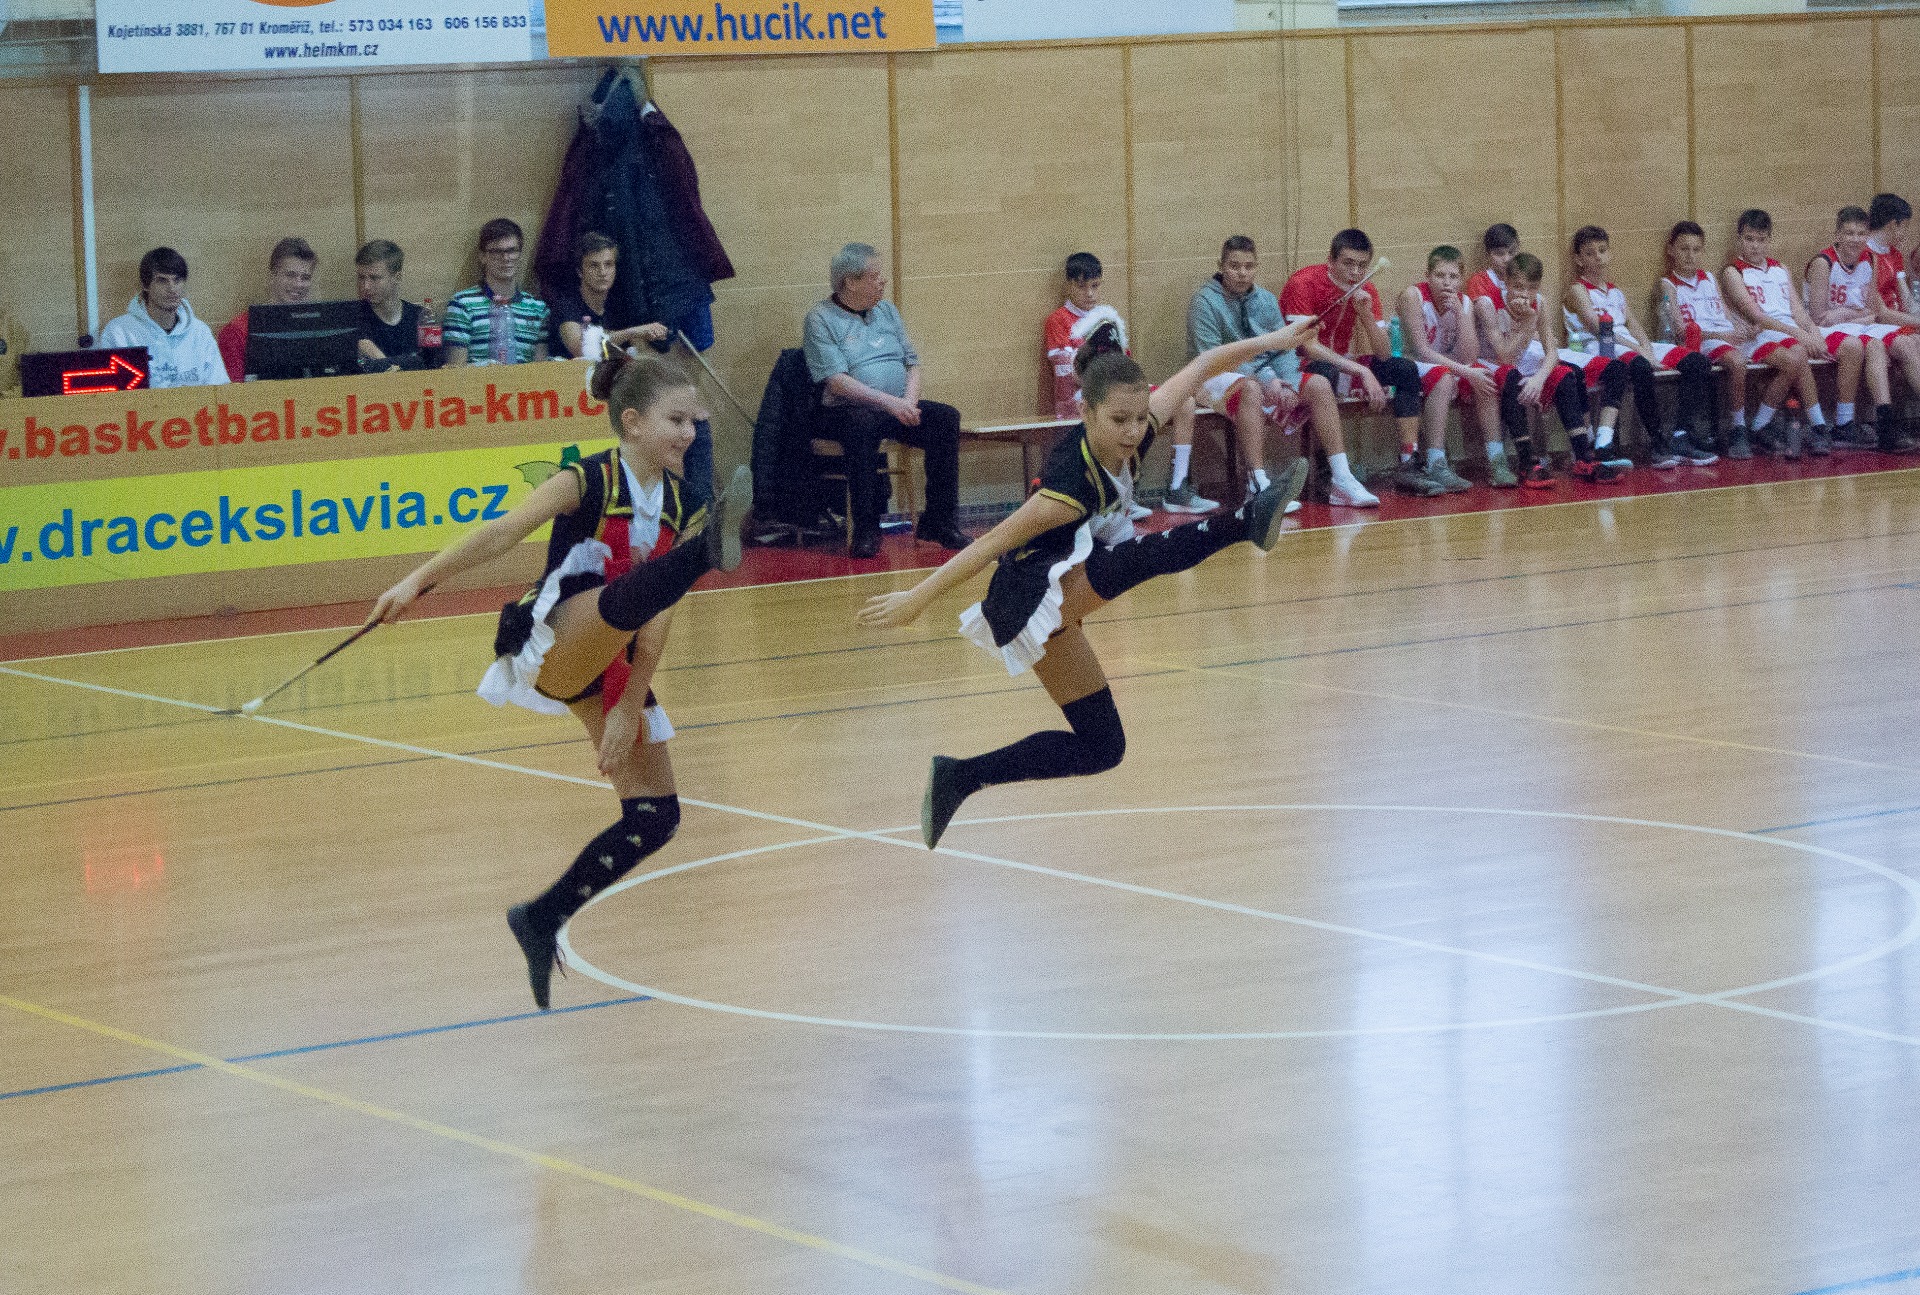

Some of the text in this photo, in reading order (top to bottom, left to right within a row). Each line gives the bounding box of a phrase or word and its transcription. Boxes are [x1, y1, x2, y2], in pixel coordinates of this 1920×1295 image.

[214, 22, 237, 36] 767
[240, 21, 254, 35] 01
[349, 19, 374, 32] 573
[378, 18, 403, 31] 034
[408, 18, 433, 31] 163
[444, 16, 469, 29] 606
[474, 16, 498, 29] 156
[502, 15, 527, 28] 833
[597, 2, 887, 43] www.hucik.net
[264, 42, 379, 59] www.helmkm.cz
[0, 384, 606, 460] .basketbal.slavia-km.c
